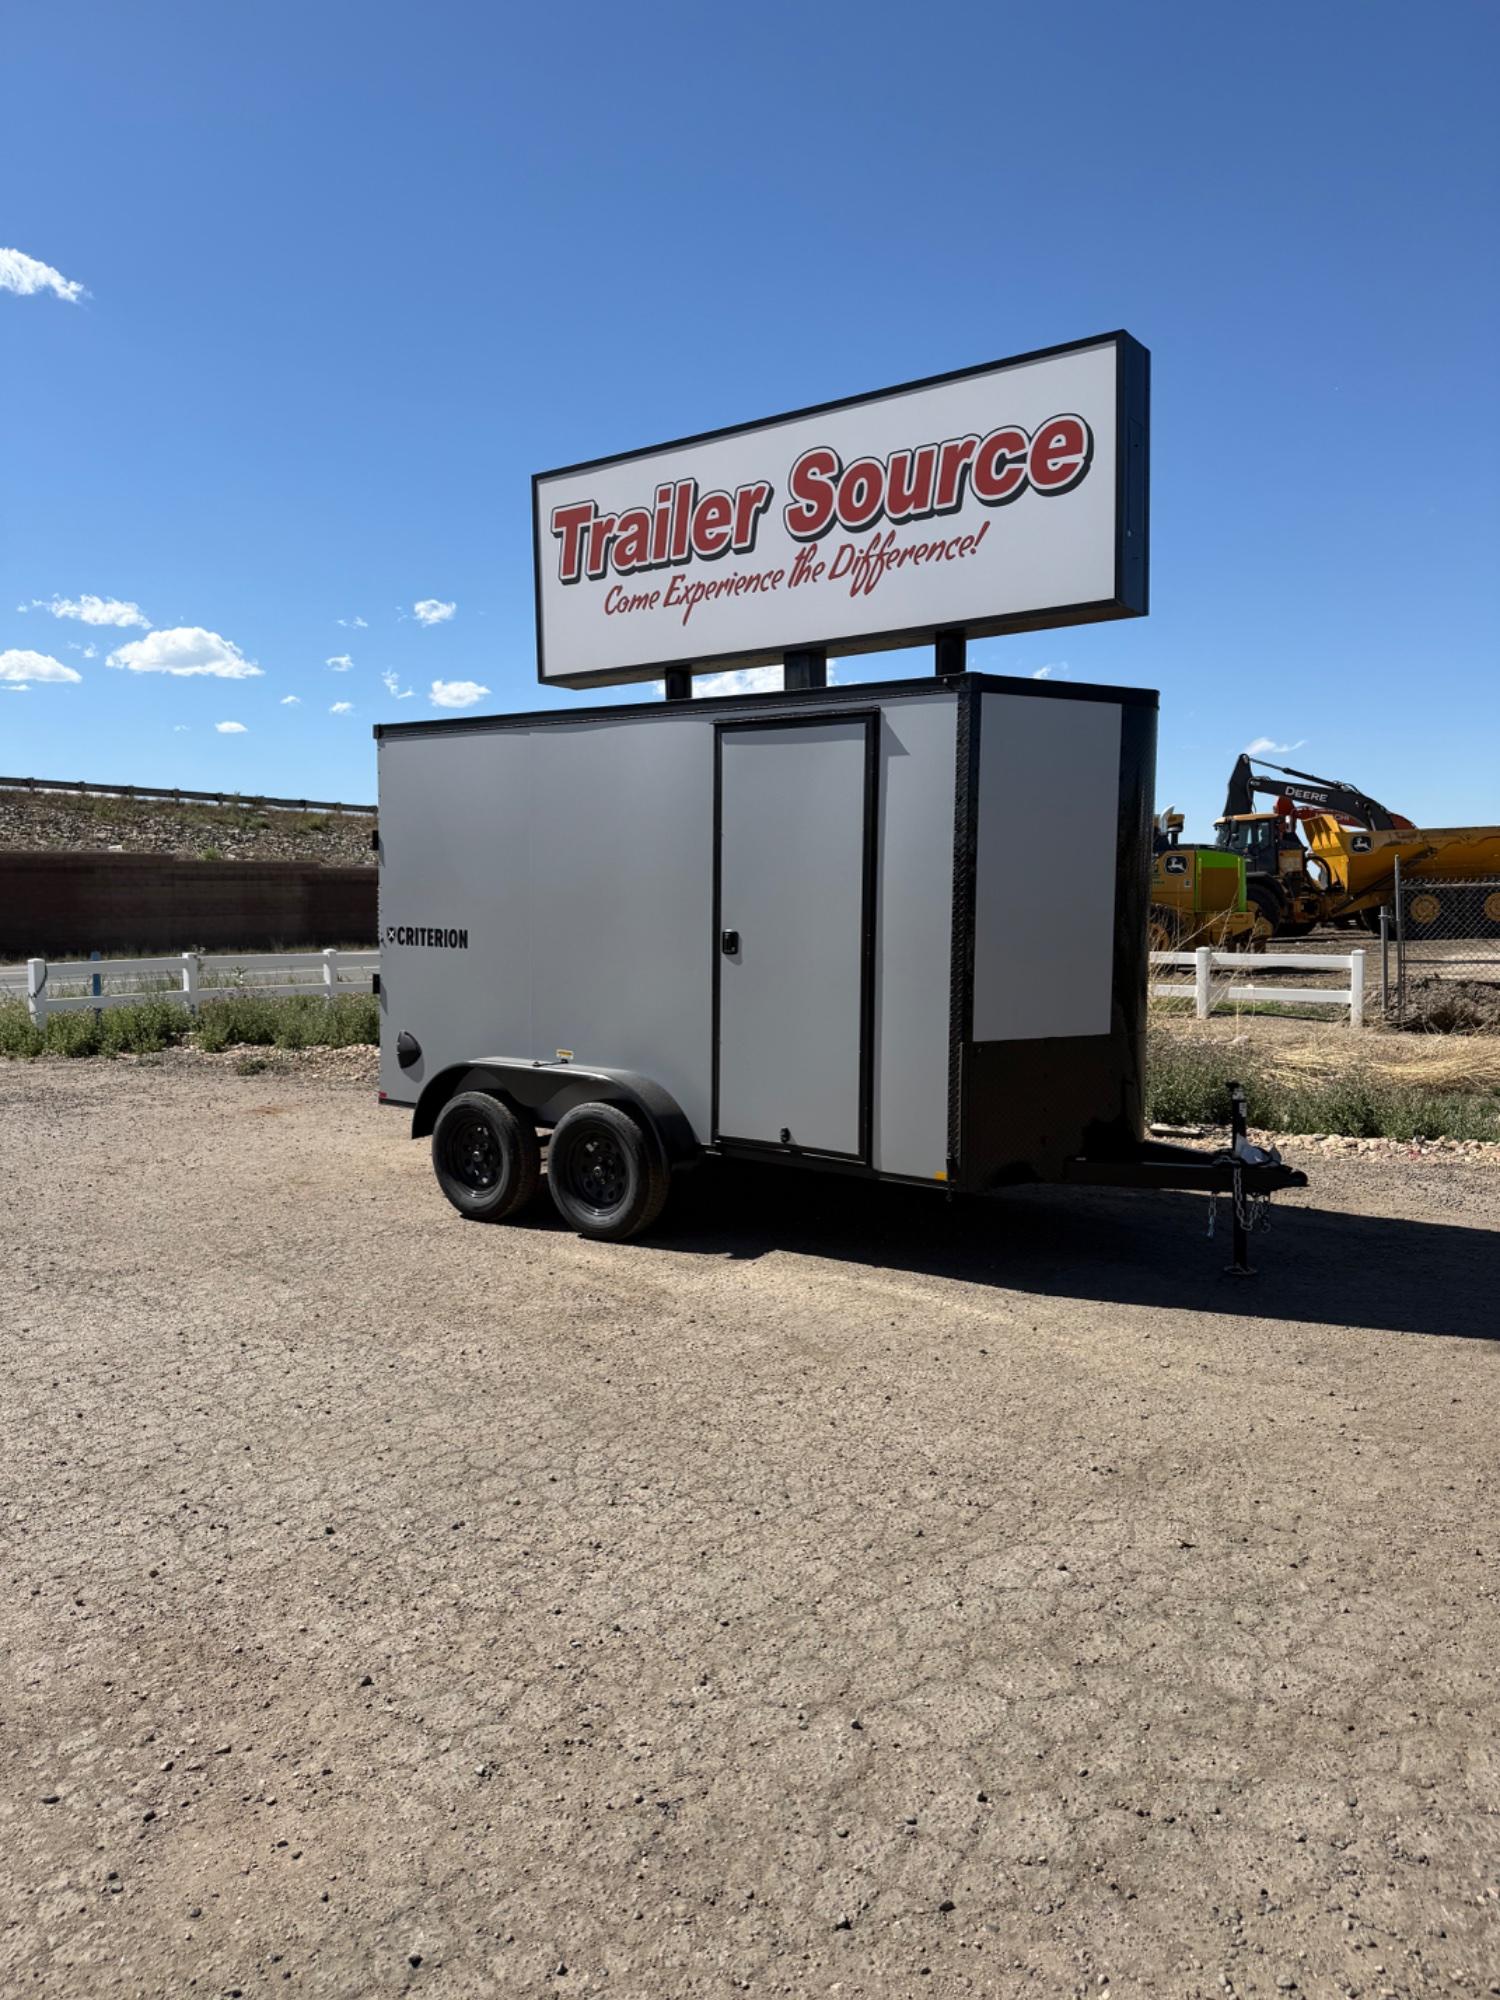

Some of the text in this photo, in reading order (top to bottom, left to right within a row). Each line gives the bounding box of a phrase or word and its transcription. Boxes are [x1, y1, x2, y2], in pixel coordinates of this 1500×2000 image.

[552, 413, 1093, 584] Trailer Source
[604, 520, 990, 626] Come Experience the Difference!
[1284, 785, 1329, 803] DEERE
[397, 926, 469, 949] CRITERION
